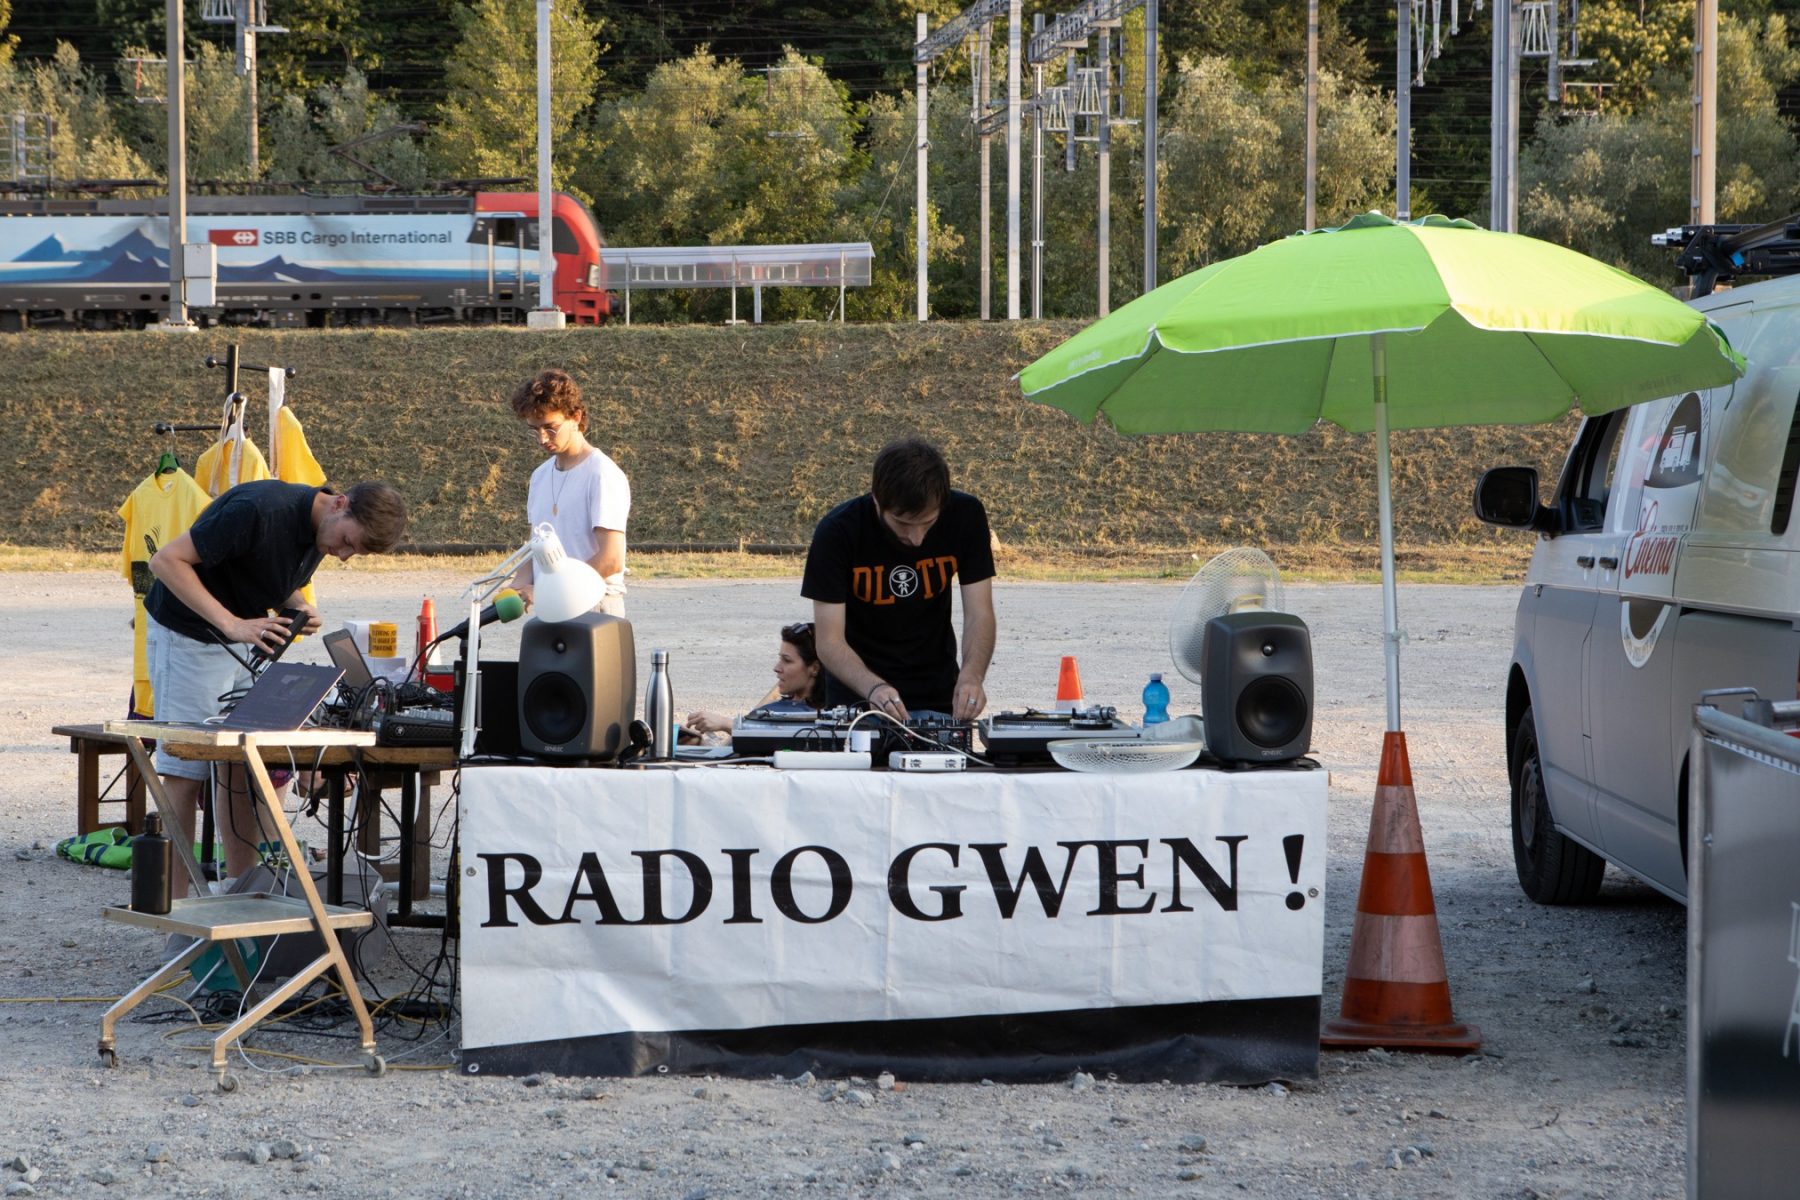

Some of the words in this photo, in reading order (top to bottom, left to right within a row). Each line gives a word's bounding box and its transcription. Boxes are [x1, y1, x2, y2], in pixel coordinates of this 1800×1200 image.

[263, 231, 297, 244] SBB
[301, 231, 347, 247] Cargo
[351, 231, 453, 244] International
[477, 845, 853, 927] RADIO
[887, 835, 1249, 921] GWEN
